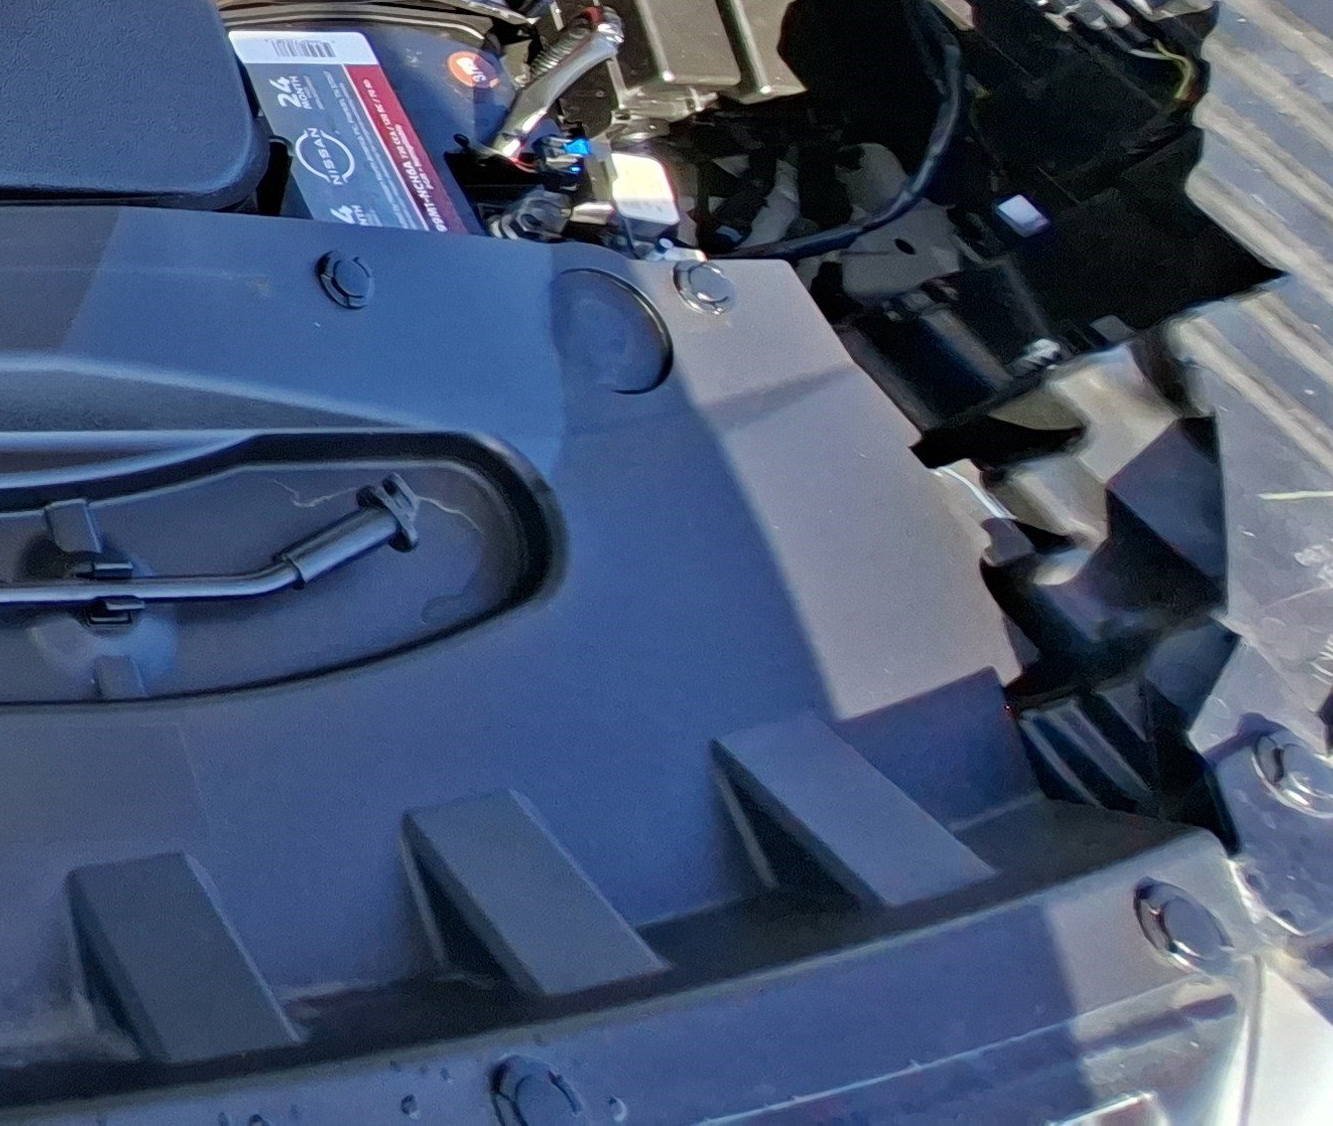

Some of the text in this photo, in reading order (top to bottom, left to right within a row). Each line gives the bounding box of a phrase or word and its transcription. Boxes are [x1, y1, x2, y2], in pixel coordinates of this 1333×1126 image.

[268, 76, 302, 108] 24
[289, 75, 312, 110] MONTH
[308, 127, 343, 186] NISSAN
